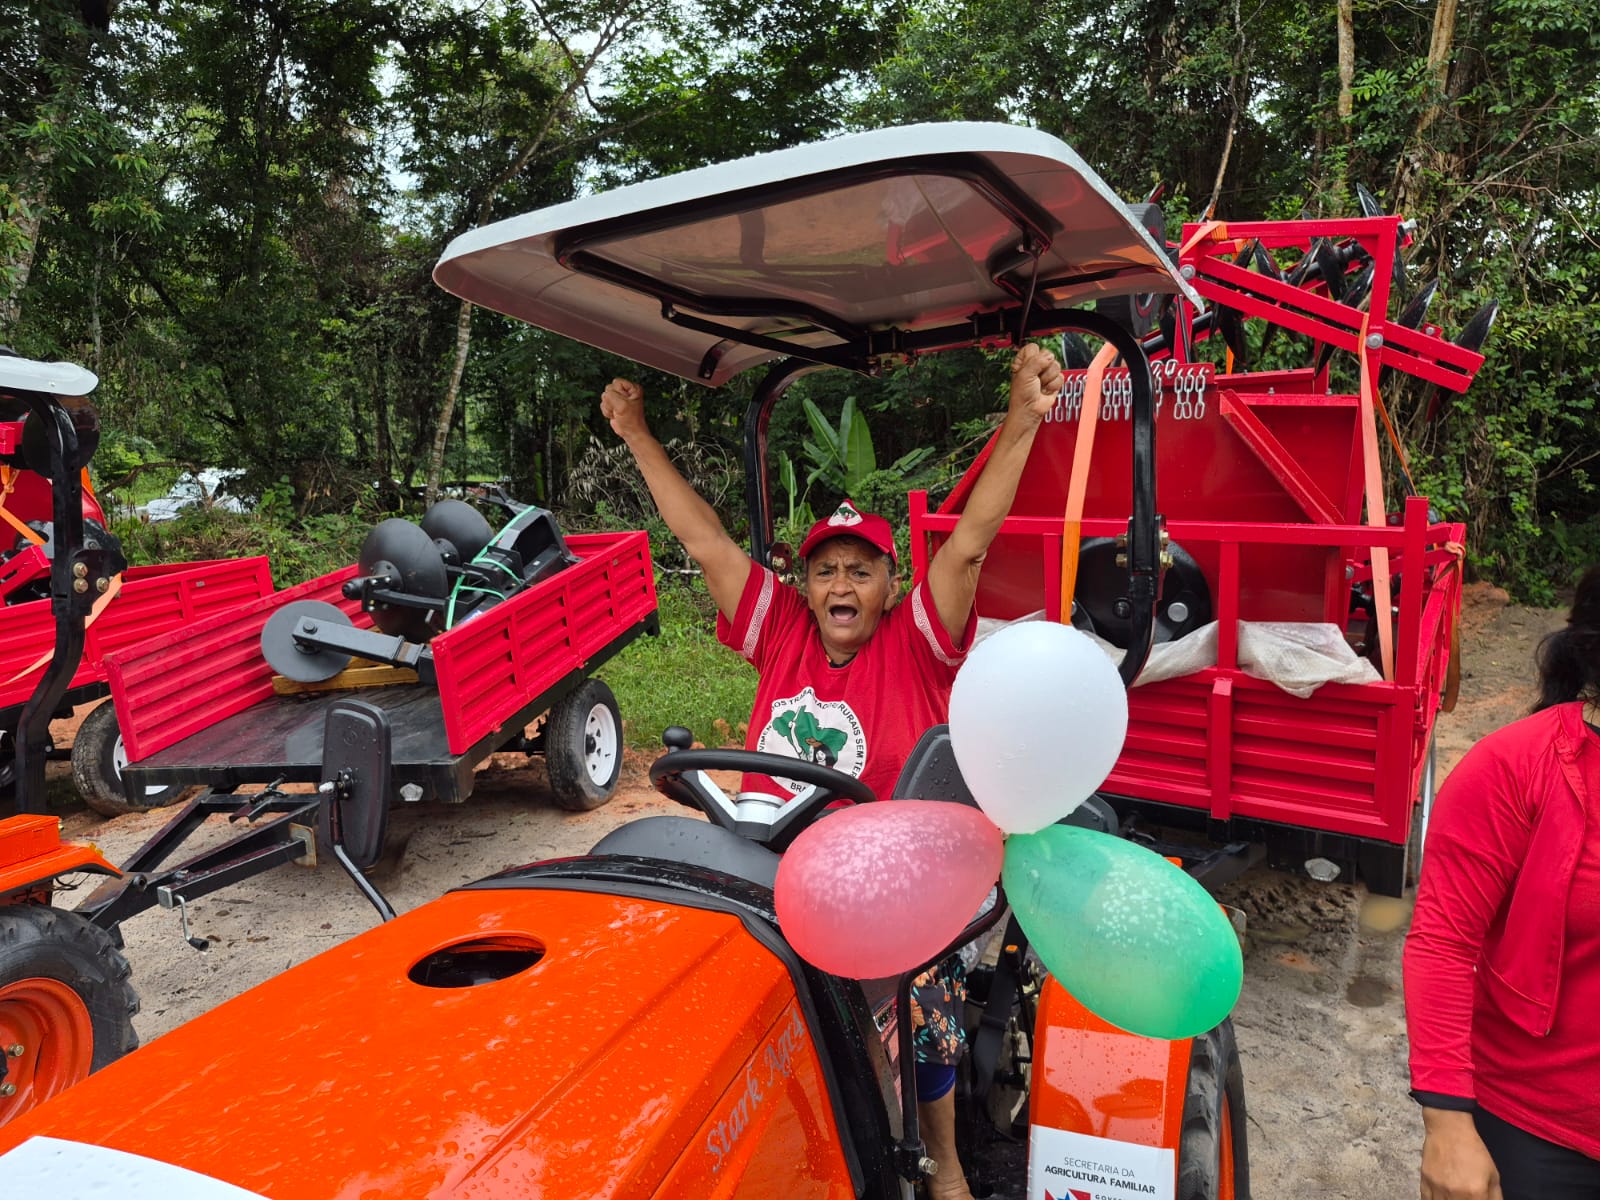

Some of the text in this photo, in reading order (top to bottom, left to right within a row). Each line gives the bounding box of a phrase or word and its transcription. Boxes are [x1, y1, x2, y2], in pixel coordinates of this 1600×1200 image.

[837, 702, 861, 736] RURAIS
[855, 738, 865, 761] SEM
[850, 761, 863, 779] TER
[706, 1063, 763, 1174] Stark
[1044, 1164, 1156, 1194] AGRICULTURA FAMILIAR
[1064, 1156, 1135, 1178] SECRETARIA DA
